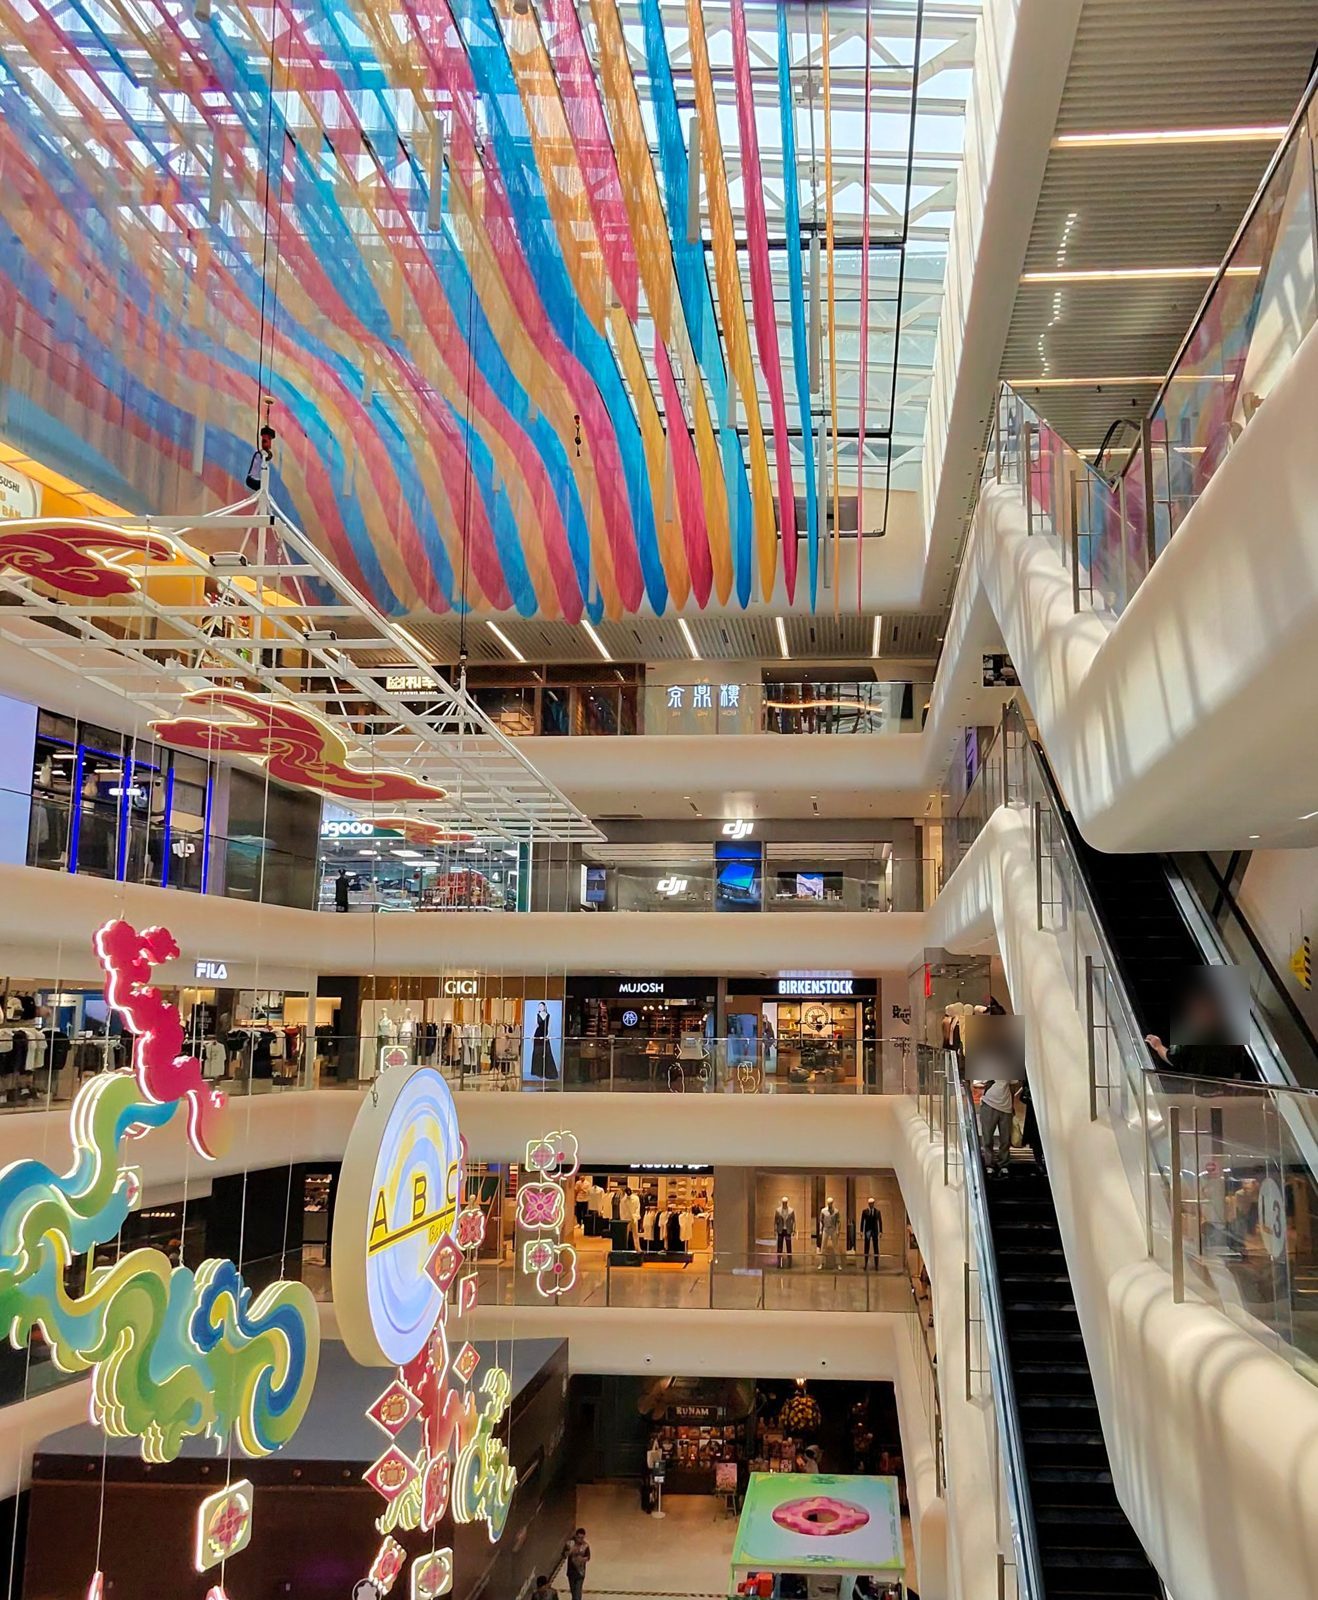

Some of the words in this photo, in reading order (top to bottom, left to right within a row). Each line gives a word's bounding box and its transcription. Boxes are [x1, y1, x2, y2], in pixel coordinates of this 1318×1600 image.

[196, 962, 228, 979] FILA
[444, 980, 477, 994] GIGI
[618, 982, 664, 993] MUJOSH
[778, 980, 853, 994] BIRKENSTOCK
[370, 1163, 457, 1241] ABC
[676, 1406, 709, 1416] RUNAM
